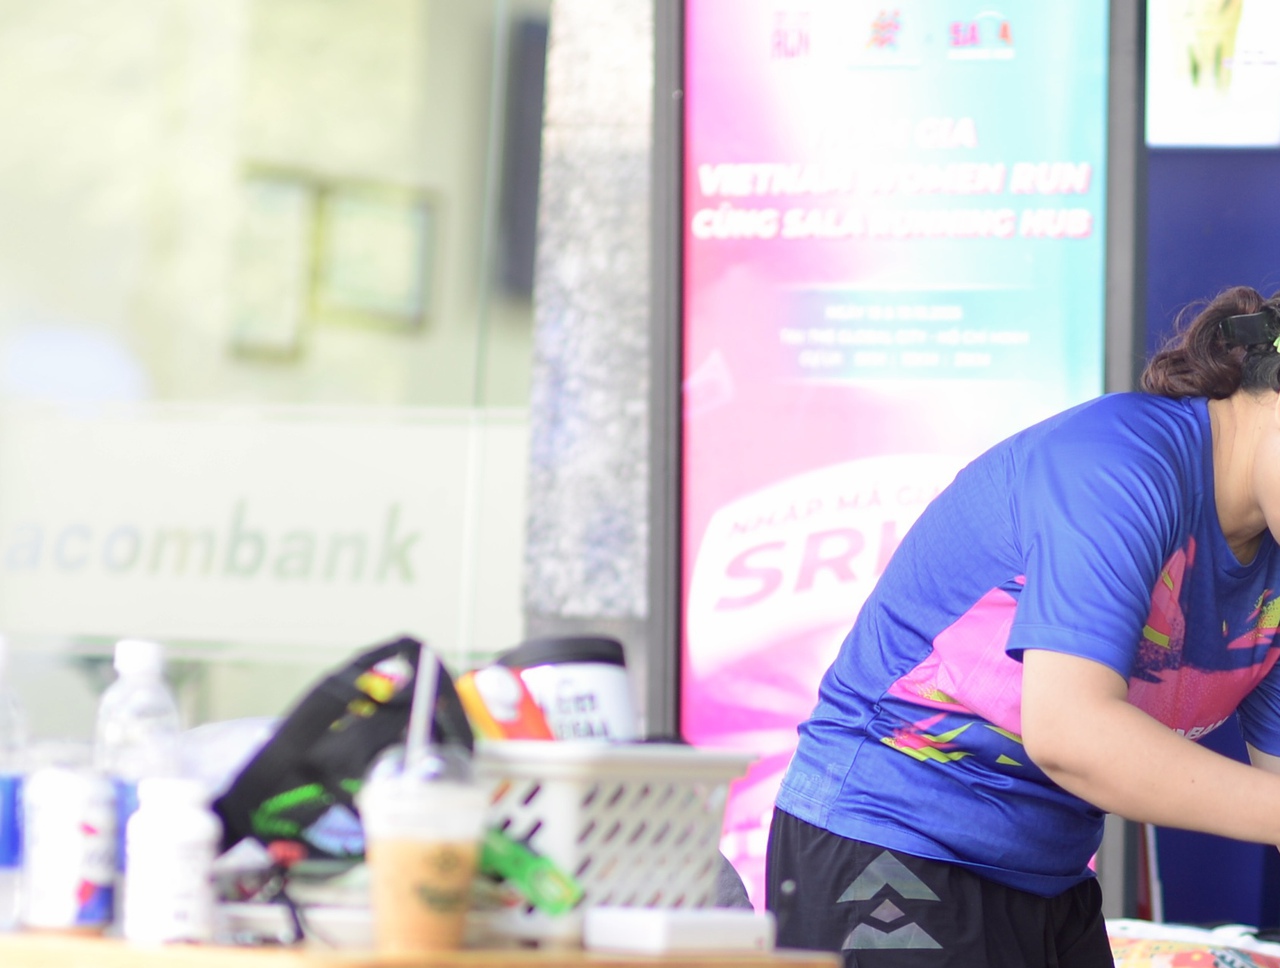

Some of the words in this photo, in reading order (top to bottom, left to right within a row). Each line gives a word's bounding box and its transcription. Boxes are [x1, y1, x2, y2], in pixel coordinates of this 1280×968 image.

[1011, 161, 1093, 195] RUN
[1019, 207, 1094, 240] HUB
[4, 494, 426, 588] acombank
